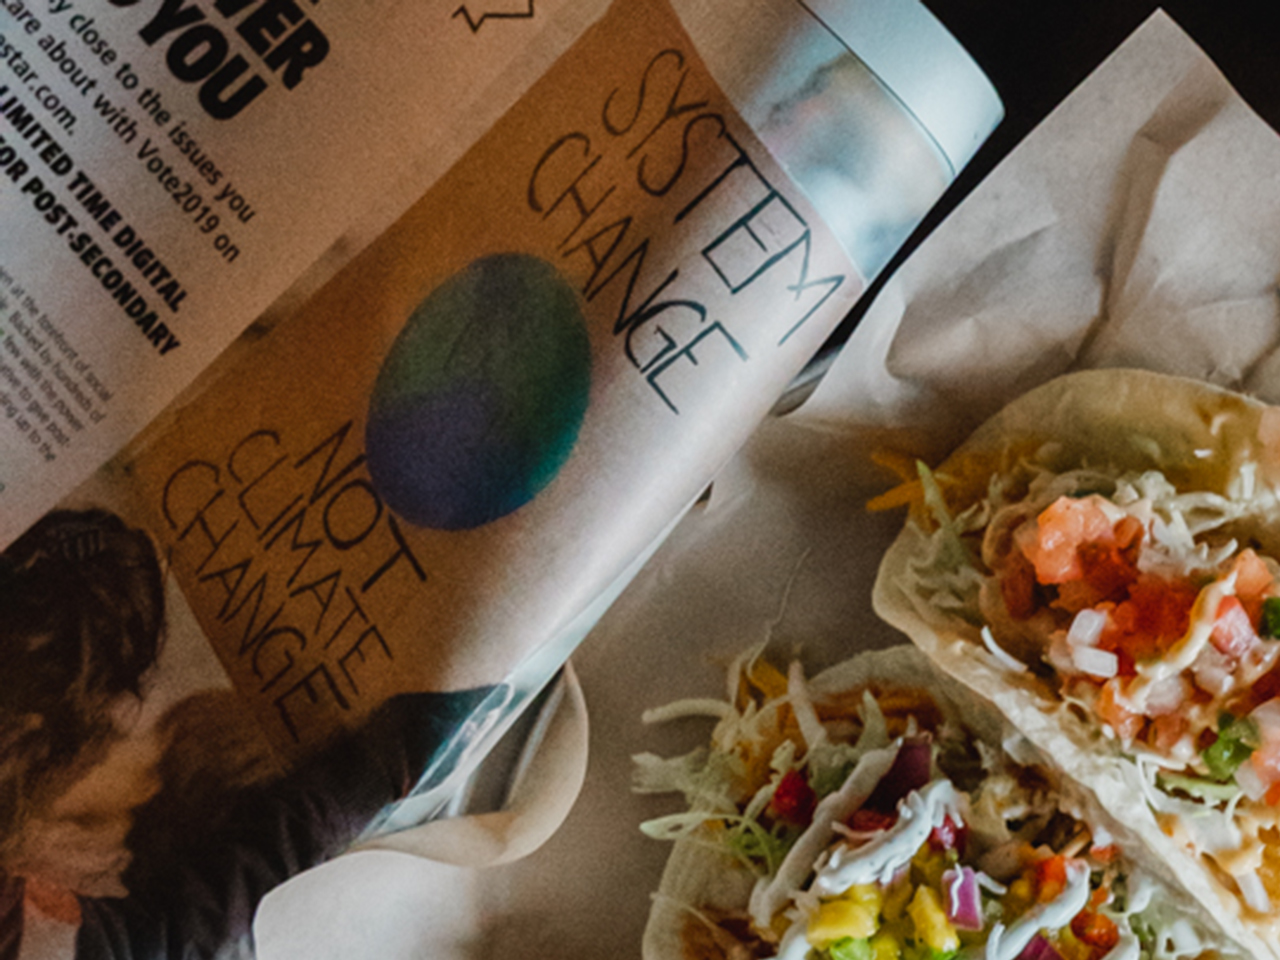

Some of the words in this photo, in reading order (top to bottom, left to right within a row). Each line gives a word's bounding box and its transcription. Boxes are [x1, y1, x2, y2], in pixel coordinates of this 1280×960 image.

[0, 0, 42, 35] are
[37, 34, 98, 97] about
[92, 91, 138, 145] with
[136, 136, 220, 236] Vote2019
[212, 232, 242, 265] on
[69, 13, 117, 67] close
[114, 62, 140, 91] to
[136, 86, 172, 128] the
[167, 120, 224, 188] issues
[214, 174, 257, 225] you
[138, 0, 268, 121] YOU
[20, 175, 182, 358] POST-SECONDARY
[66, 168, 123, 233] TIME
[112, 223, 190, 314] DIGITAL
[527, 131, 750, 416] CHANGE
[602, 48, 847, 347] SYSTEM
[161, 459, 351, 744] CHANGE
[227, 429, 395, 697] CLIMATE
[293, 419, 428, 594] NOT
